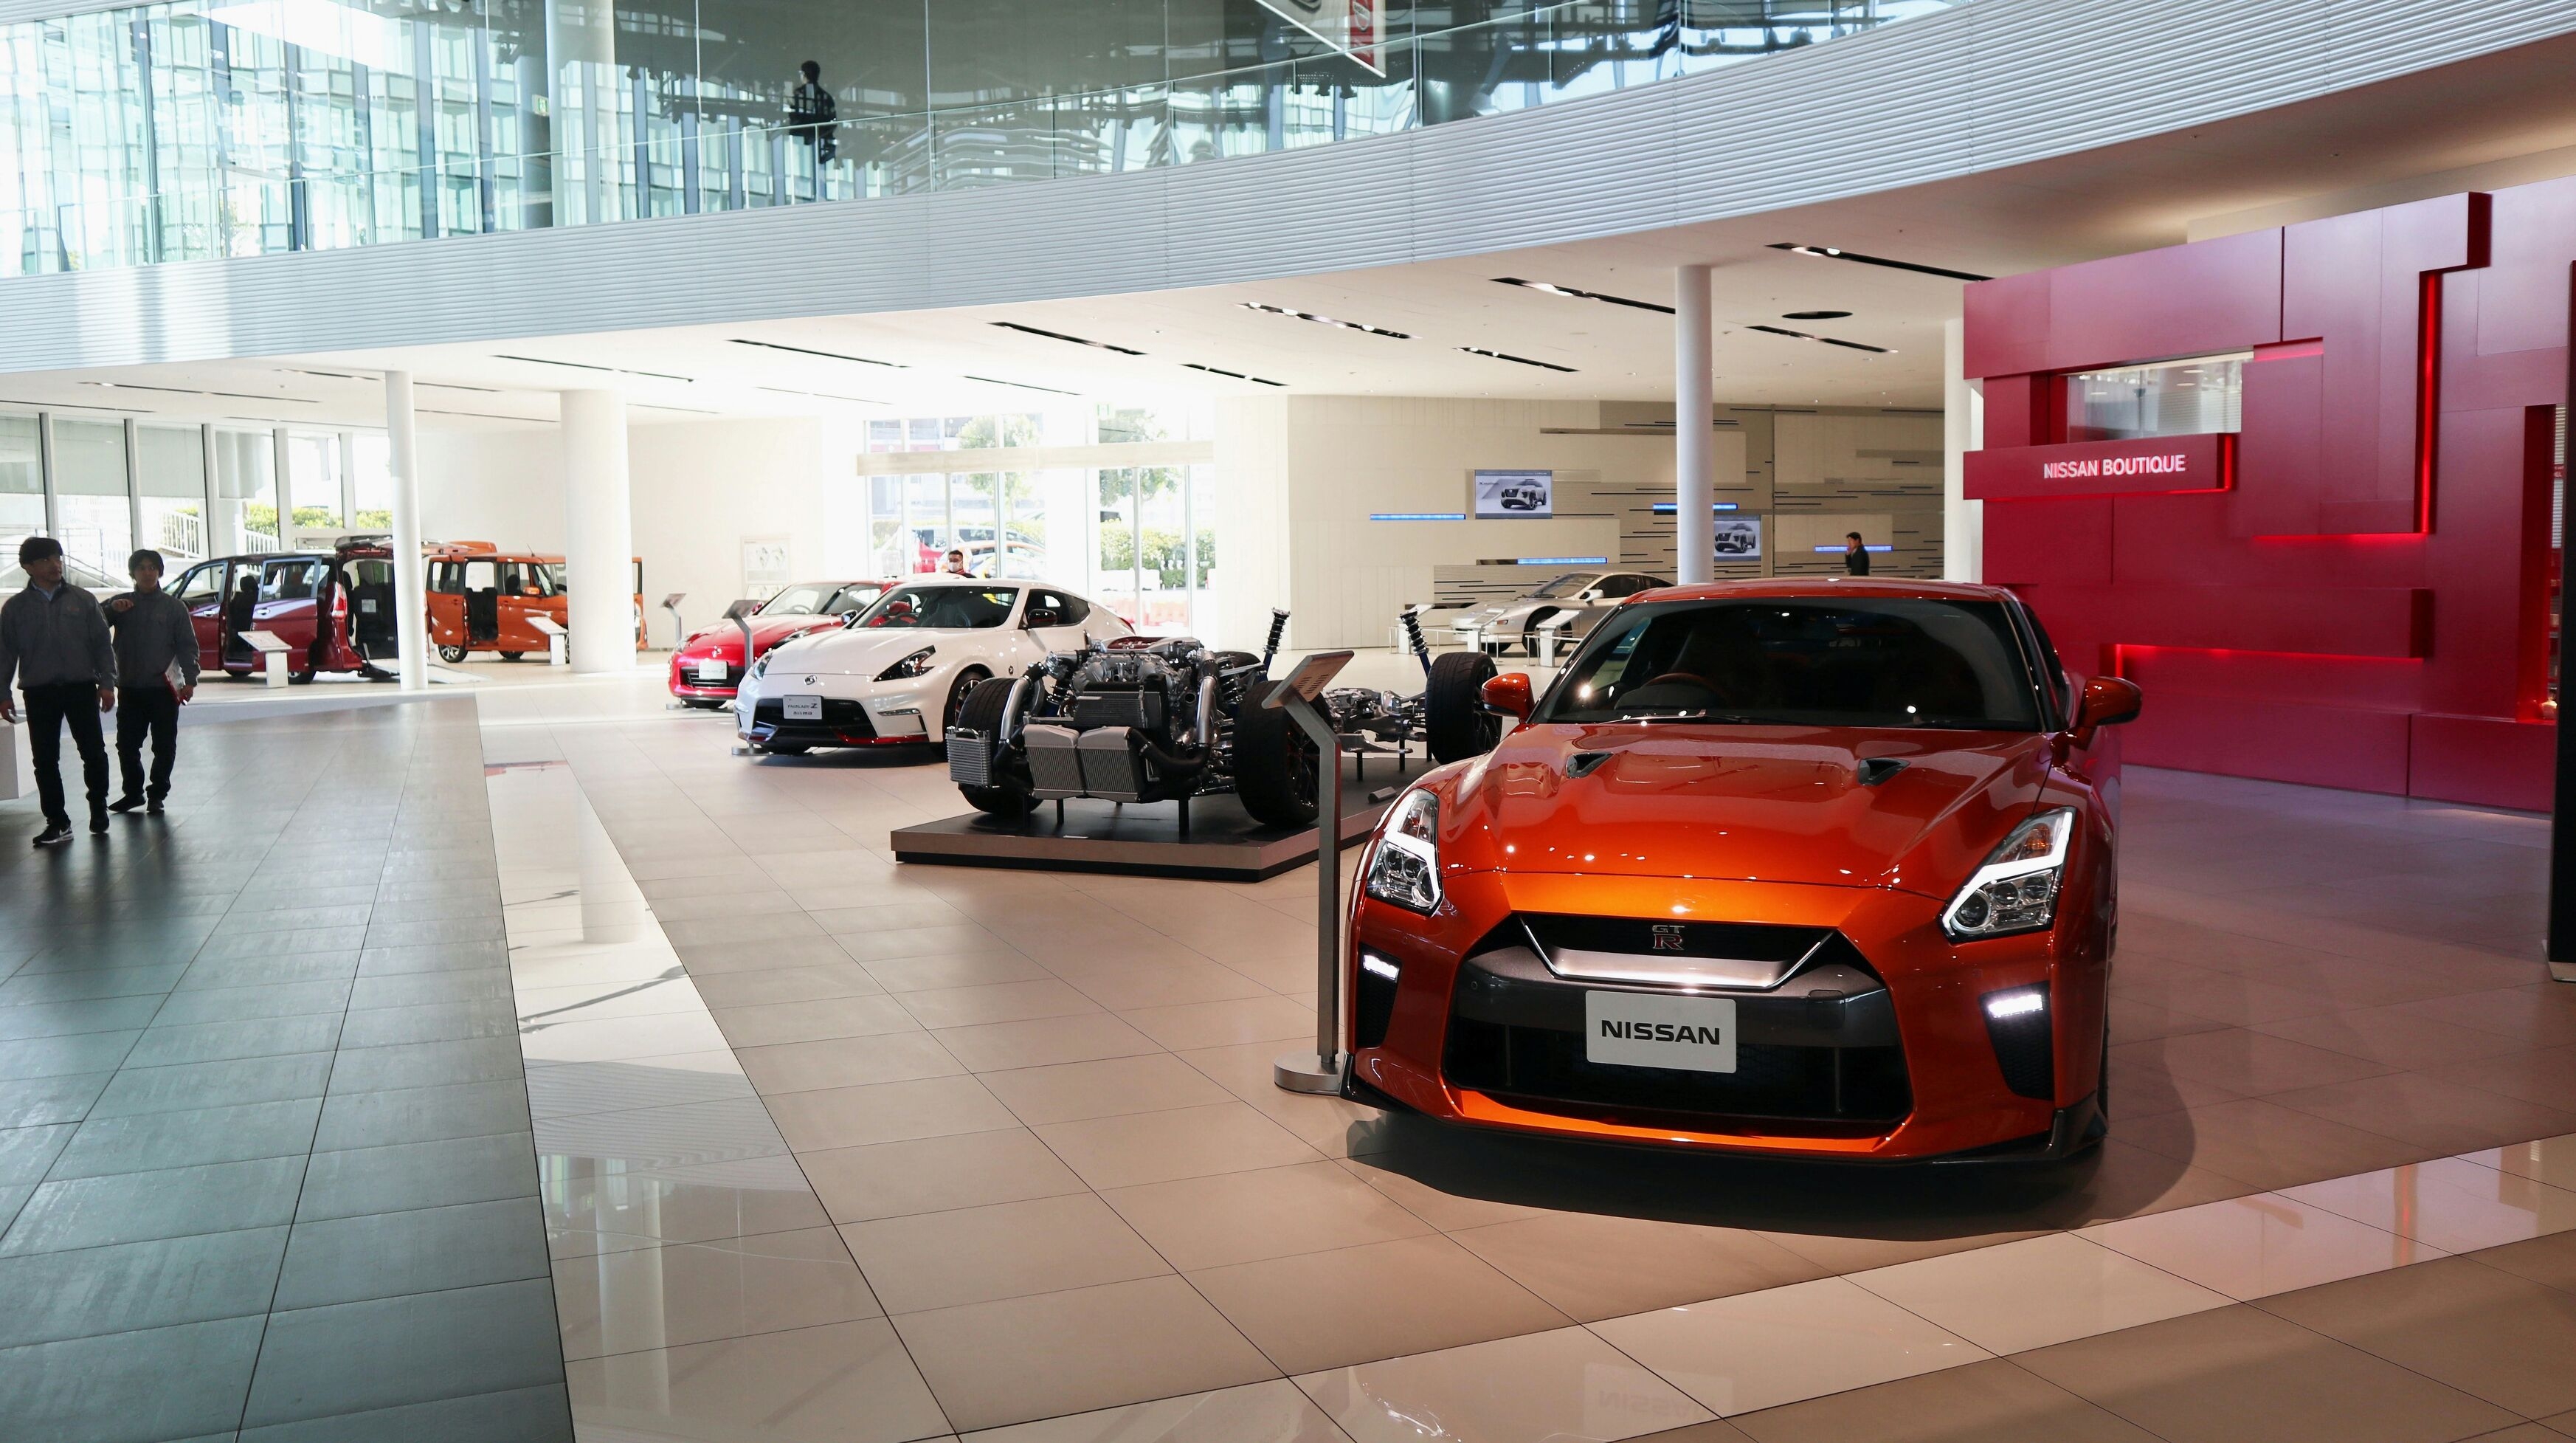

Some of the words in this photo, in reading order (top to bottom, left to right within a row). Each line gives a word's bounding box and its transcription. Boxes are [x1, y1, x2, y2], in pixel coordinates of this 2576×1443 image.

[2044, 460, 2099, 479] NISSAN
[2103, 454, 2186, 476] BOUTIQUE
[1652, 925, 1685, 933] GT
[1653, 934, 1685, 951] R
[1601, 1019, 1720, 1046] NISSAN
